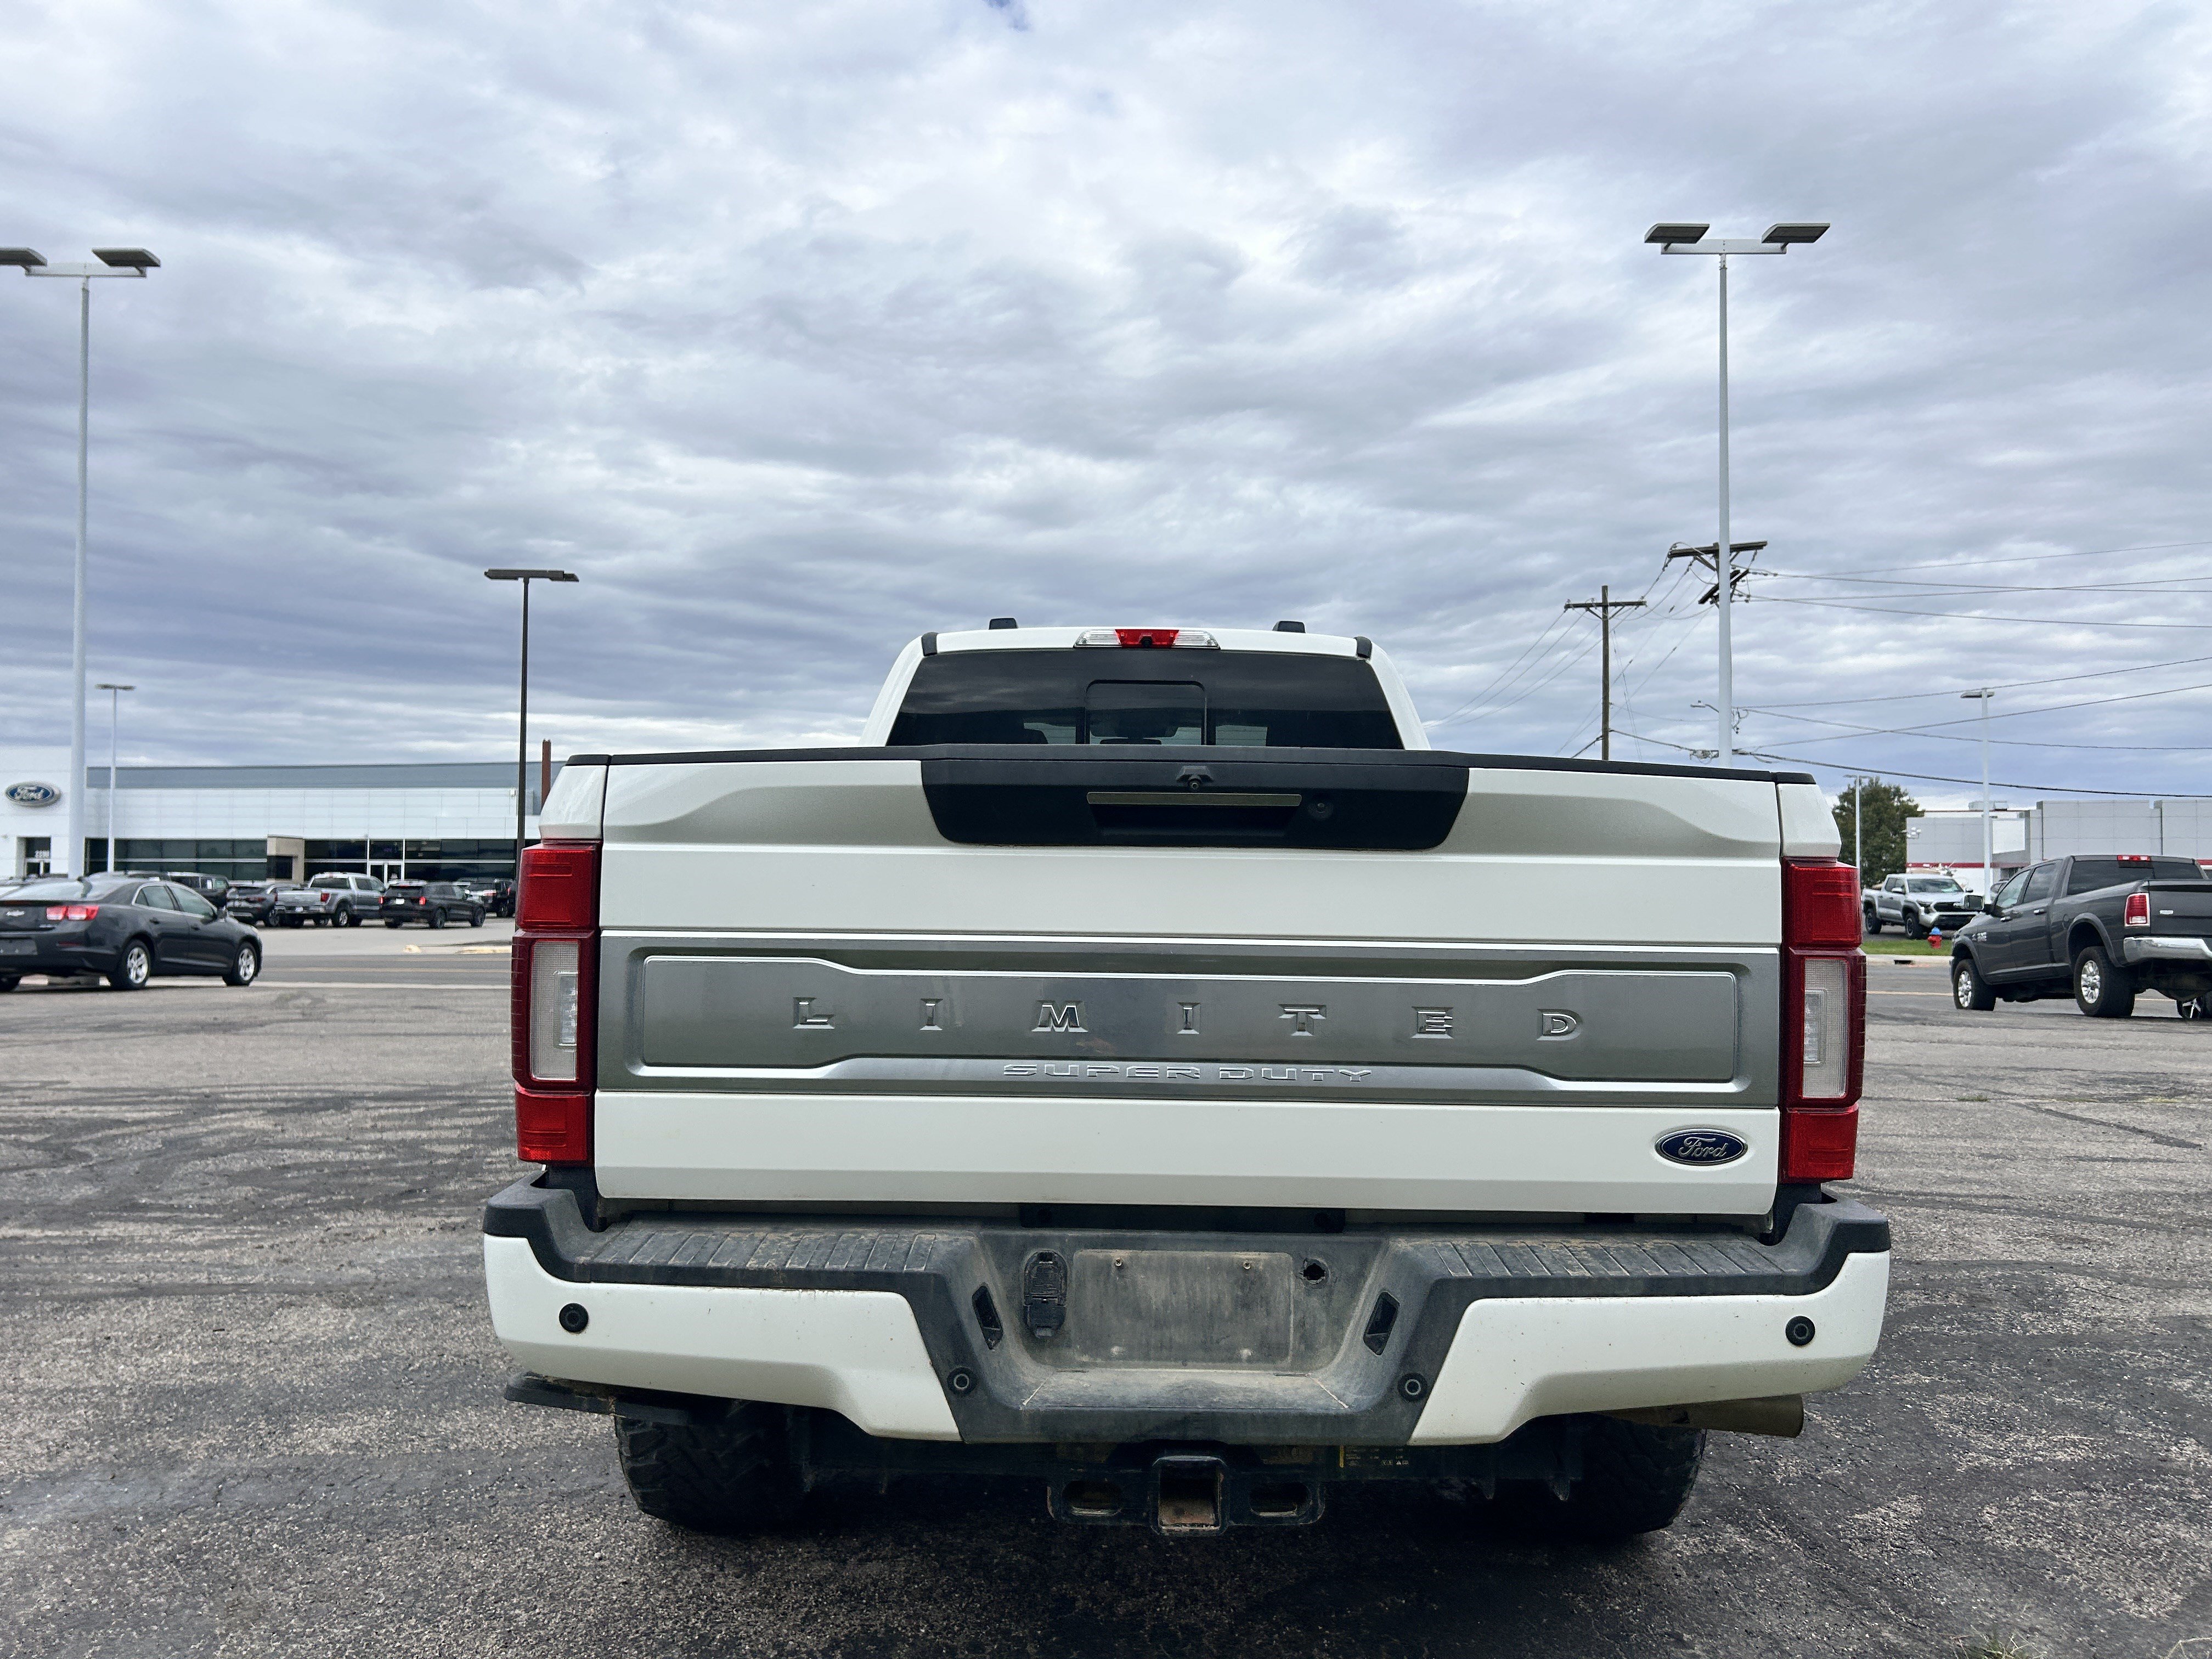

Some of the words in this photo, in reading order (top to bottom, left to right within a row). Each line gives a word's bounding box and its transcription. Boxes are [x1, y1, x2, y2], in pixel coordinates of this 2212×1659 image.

[14, 786, 44, 800] Ford
[793, 996, 1583, 1041] LIMITED
[1003, 1064, 1201, 1079] SUPER
[1218, 1066, 1372, 1082] DUTY
[1678, 1137, 1728, 1158] Ford
